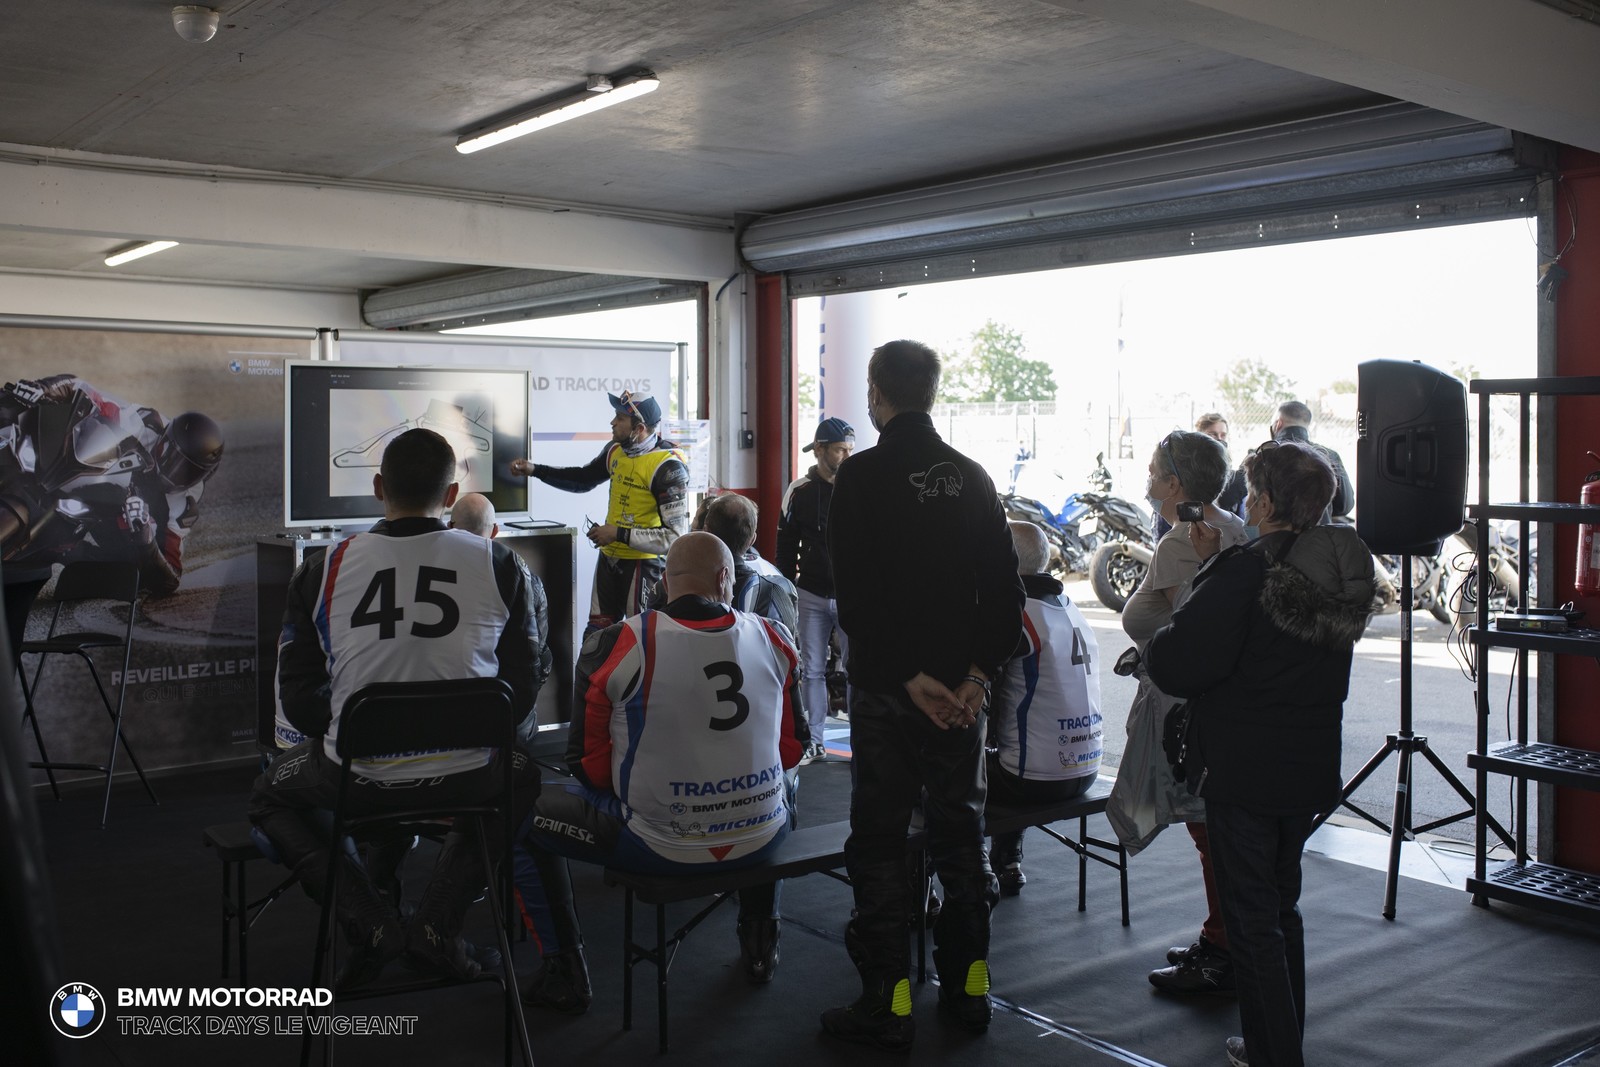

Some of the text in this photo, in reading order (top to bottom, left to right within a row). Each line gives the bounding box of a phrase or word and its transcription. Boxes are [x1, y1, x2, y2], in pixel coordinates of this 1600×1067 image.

[247, 359, 271, 368] BMW
[555, 377, 609, 392] TRACK
[612, 378, 651, 393] DAYS
[350, 565, 460, 640] 45
[1071, 626, 1092, 675] 4
[215, 660, 236, 676] LE
[703, 660, 750, 731] 3
[692, 801, 728, 813] BMW
